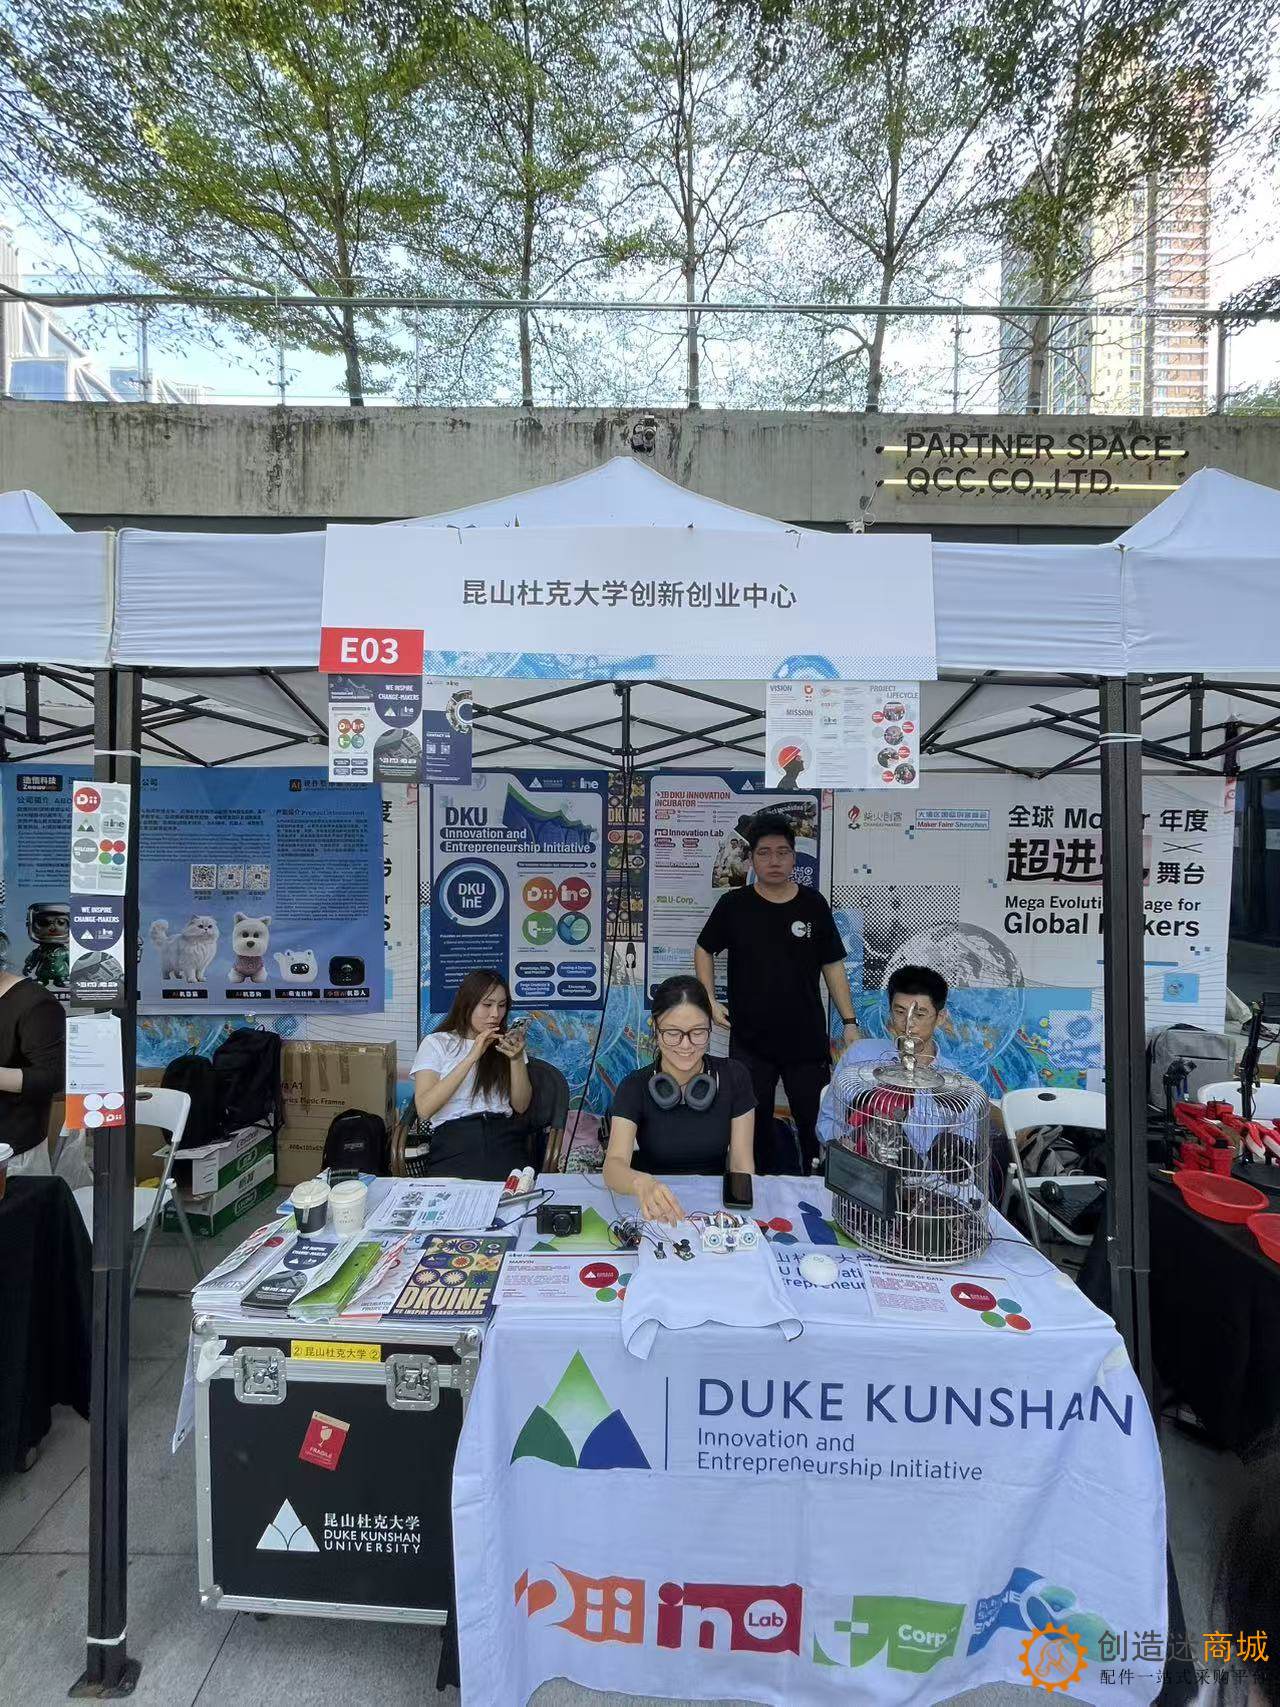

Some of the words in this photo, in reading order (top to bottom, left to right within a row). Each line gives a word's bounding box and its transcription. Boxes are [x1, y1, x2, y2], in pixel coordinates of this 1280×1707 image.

[906, 433, 1054, 460] PARTNER
[1067, 434, 1172, 461] SPACE
[462, 579, 797, 610] 昆山杜克大学创新创业中心
[340, 636, 399, 665] E03
[378, 693, 420, 701] CHANGE-MAKERS
[786, 709, 813, 717] MISSION
[654, 799, 696, 808] INCUBATOR
[686, 791, 731, 800] INNOVATION
[445, 806, 488, 827] DKU
[1008, 805, 1054, 829] 全球
[1159, 809, 1209, 832] 年度
[445, 829, 504, 839] Innovation
[506, 829, 527, 839] and
[669, 828, 709, 838] Innovation
[709, 828, 724, 837] Lab
[445, 841, 541, 854] Entrepreneurship
[543, 841, 591, 853] Initiative
[1156, 861, 1205, 885] 舞台
[458, 883, 485, 895] DKU
[461, 896, 482, 908] InE
[1005, 895, 1045, 911] Mega
[1049, 895, 1103, 909] Evoluti
[1177, 898, 1202, 911] for
[1004, 912, 1089, 935] Global
[396, 1286, 492, 1310] DKUINE
[305, 1346, 367, 1359] 昆山杜克大学
[697, 1378, 845, 1421] DUKE
[866, 1383, 1133, 1436] KUNSHAN
[697, 1427, 809, 1450] Innovation
[816, 1433, 855, 1452] and
[310, 1445, 333, 1458] FRAGILE
[697, 1451, 882, 1481] Entrepreneurship
[890, 1459, 983, 1481] Initiative
[324, 1513, 420, 1530] 昆山杜克大学
[324, 1529, 357, 1541] DUKE
[360, 1530, 421, 1543] KUNSHAN
[324, 1541, 421, 1555] UNIVERSITY
[748, 1611, 784, 1629] Lab
